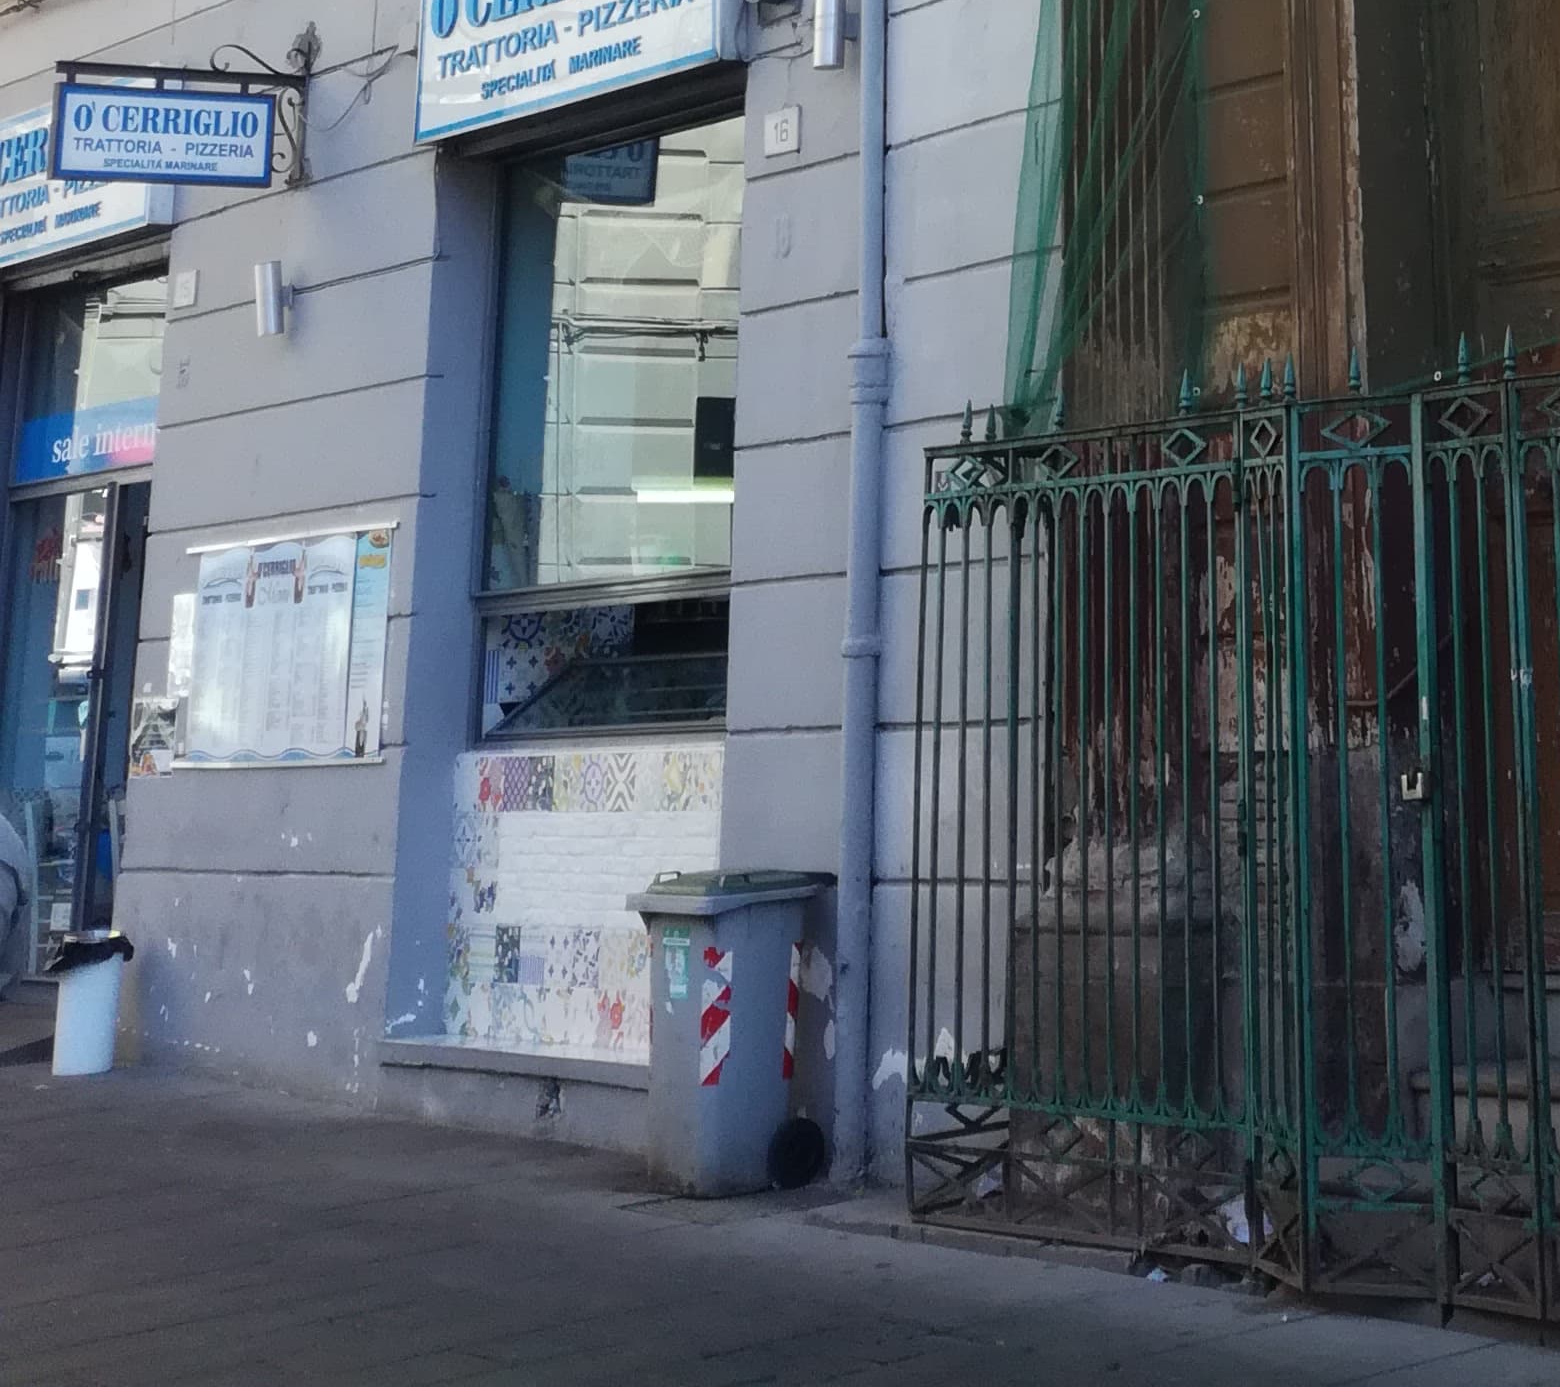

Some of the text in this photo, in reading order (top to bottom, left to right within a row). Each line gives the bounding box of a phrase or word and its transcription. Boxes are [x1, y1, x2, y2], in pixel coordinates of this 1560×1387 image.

[438, 20, 560, 81] TRATTORIA
[568, 36, 643, 74] MARINARE
[102, 104, 260, 139] CERRIGLIO
[773, 119, 790, 144] 16
[73, 137, 163, 155] TRATTORIA
[185, 142, 255, 159] PIZZERIA
[165, 160, 219, 172] MARINARE
[51, 426, 90, 464] sale
